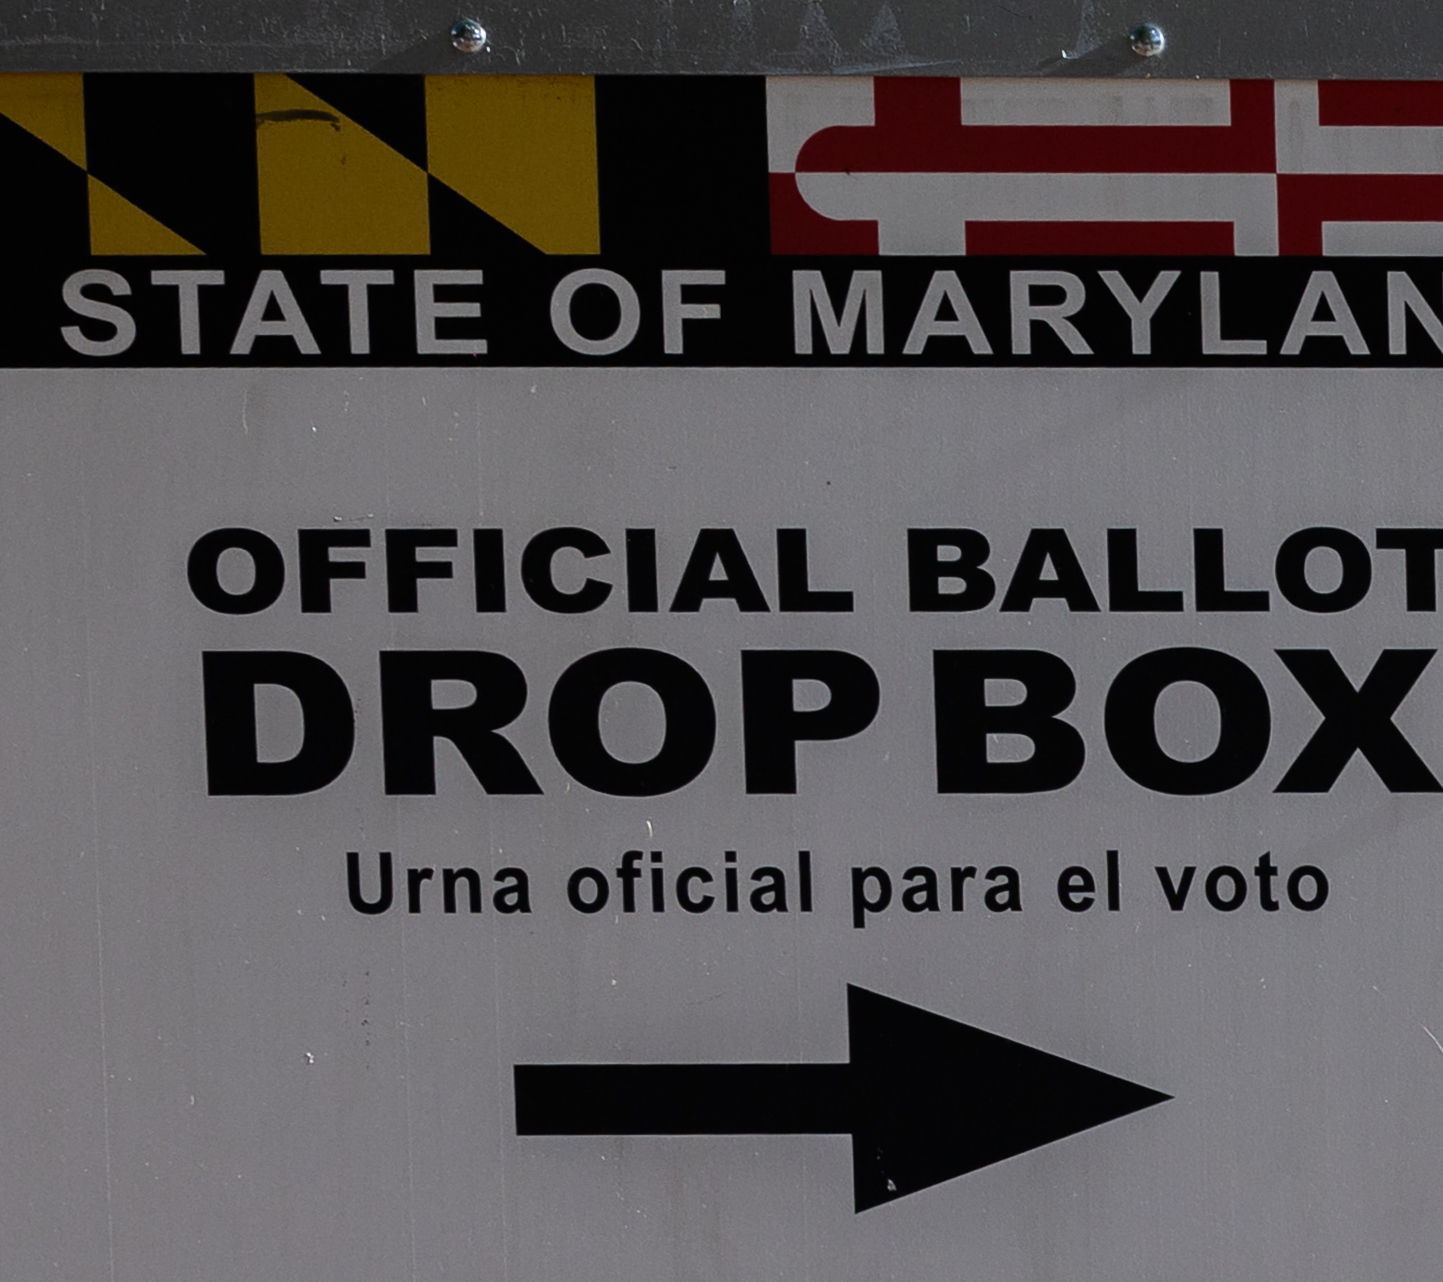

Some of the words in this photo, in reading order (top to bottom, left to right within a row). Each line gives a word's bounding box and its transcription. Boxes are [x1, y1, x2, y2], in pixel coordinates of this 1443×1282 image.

[61, 269, 487, 356] STATE
[550, 268, 725, 355] OF
[187, 527, 853, 614] OFFICIAL
[202, 648, 879, 797] DROP
[347, 852, 531, 914] Urna
[567, 851, 812, 913] oficial
[852, 866, 1022, 928] para
[1058, 850, 1119, 912] el
[1155, 852, 1328, 911] voto
